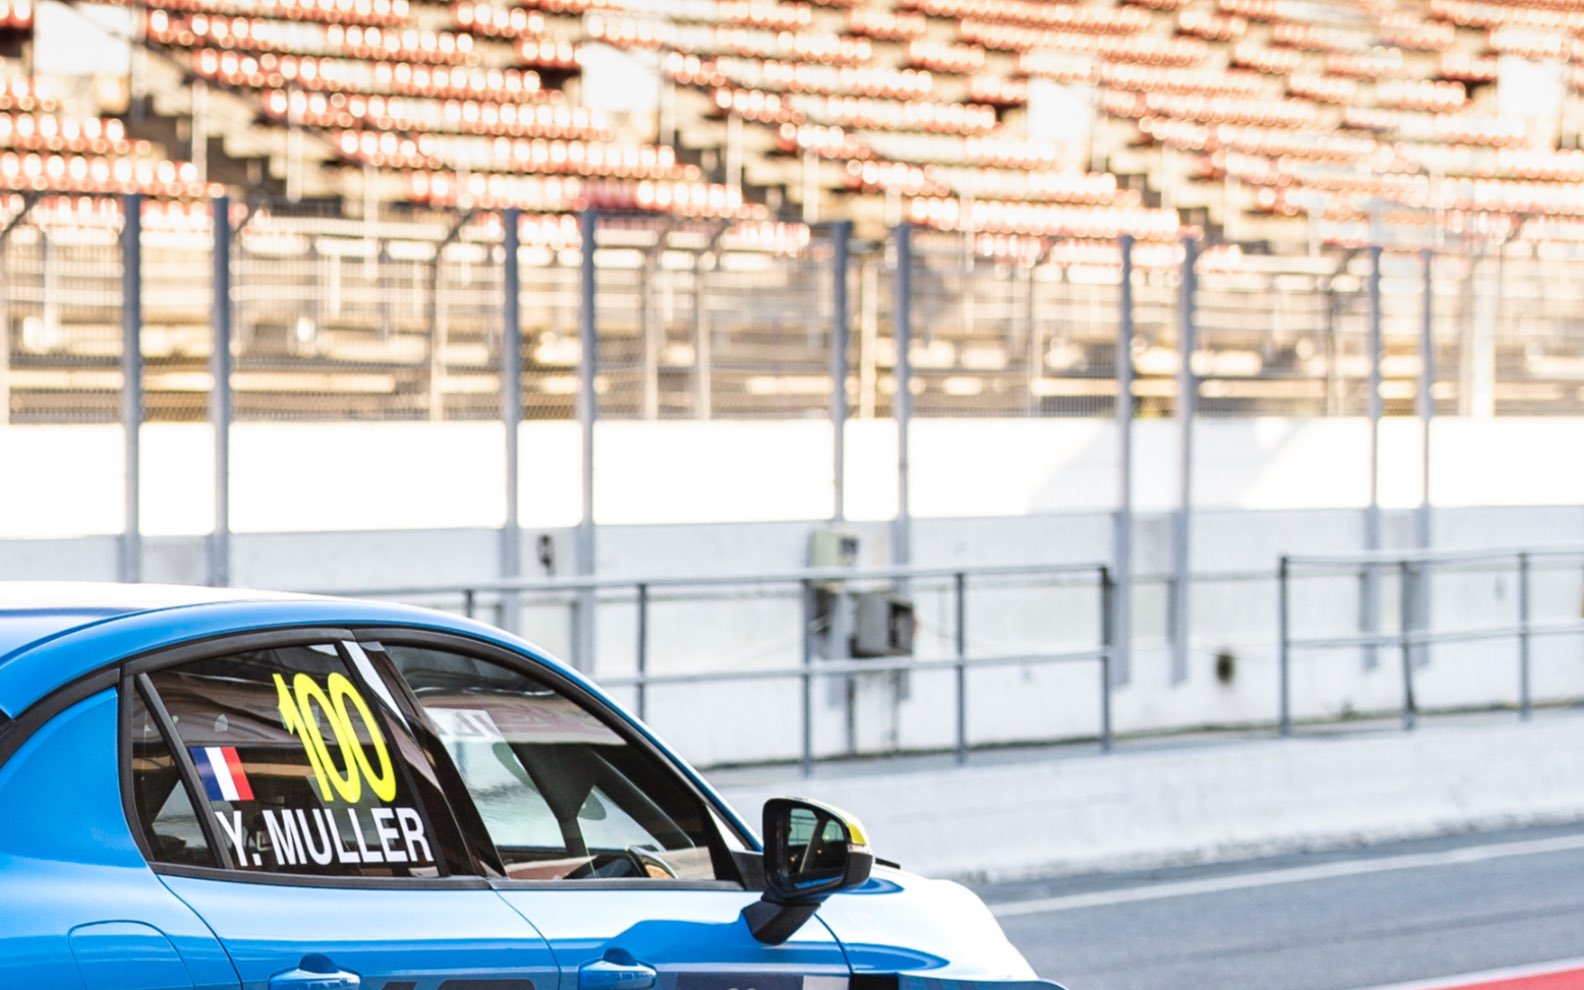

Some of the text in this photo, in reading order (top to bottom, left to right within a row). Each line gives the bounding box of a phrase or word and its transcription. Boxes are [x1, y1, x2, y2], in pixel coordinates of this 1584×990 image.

[273, 671, 397, 804] 100
[215, 808, 435, 867] Y. MULLER
